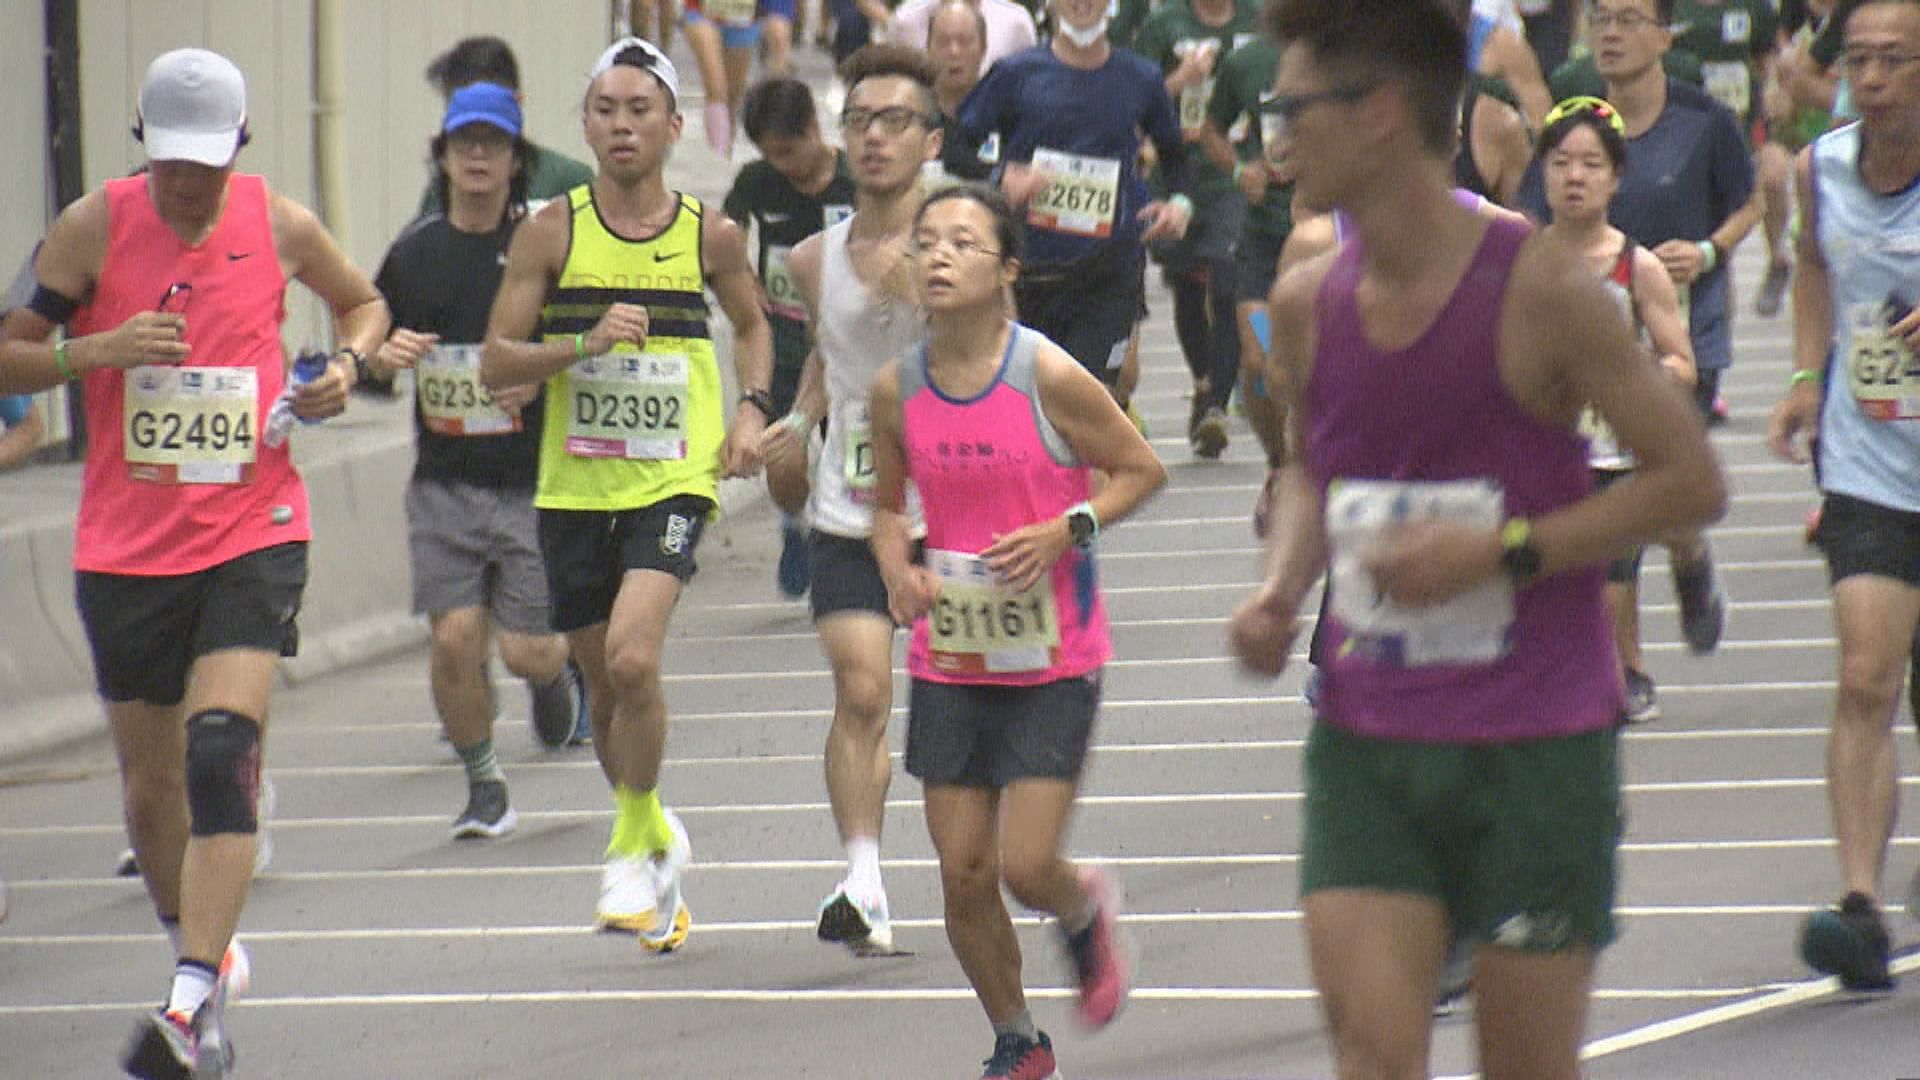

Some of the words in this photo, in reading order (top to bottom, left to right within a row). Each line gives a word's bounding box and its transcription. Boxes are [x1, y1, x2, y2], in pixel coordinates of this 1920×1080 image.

[130, 410, 251, 450] G2494
[576, 392, 680, 429] D2392
[936, 597, 1046, 638] G1161
